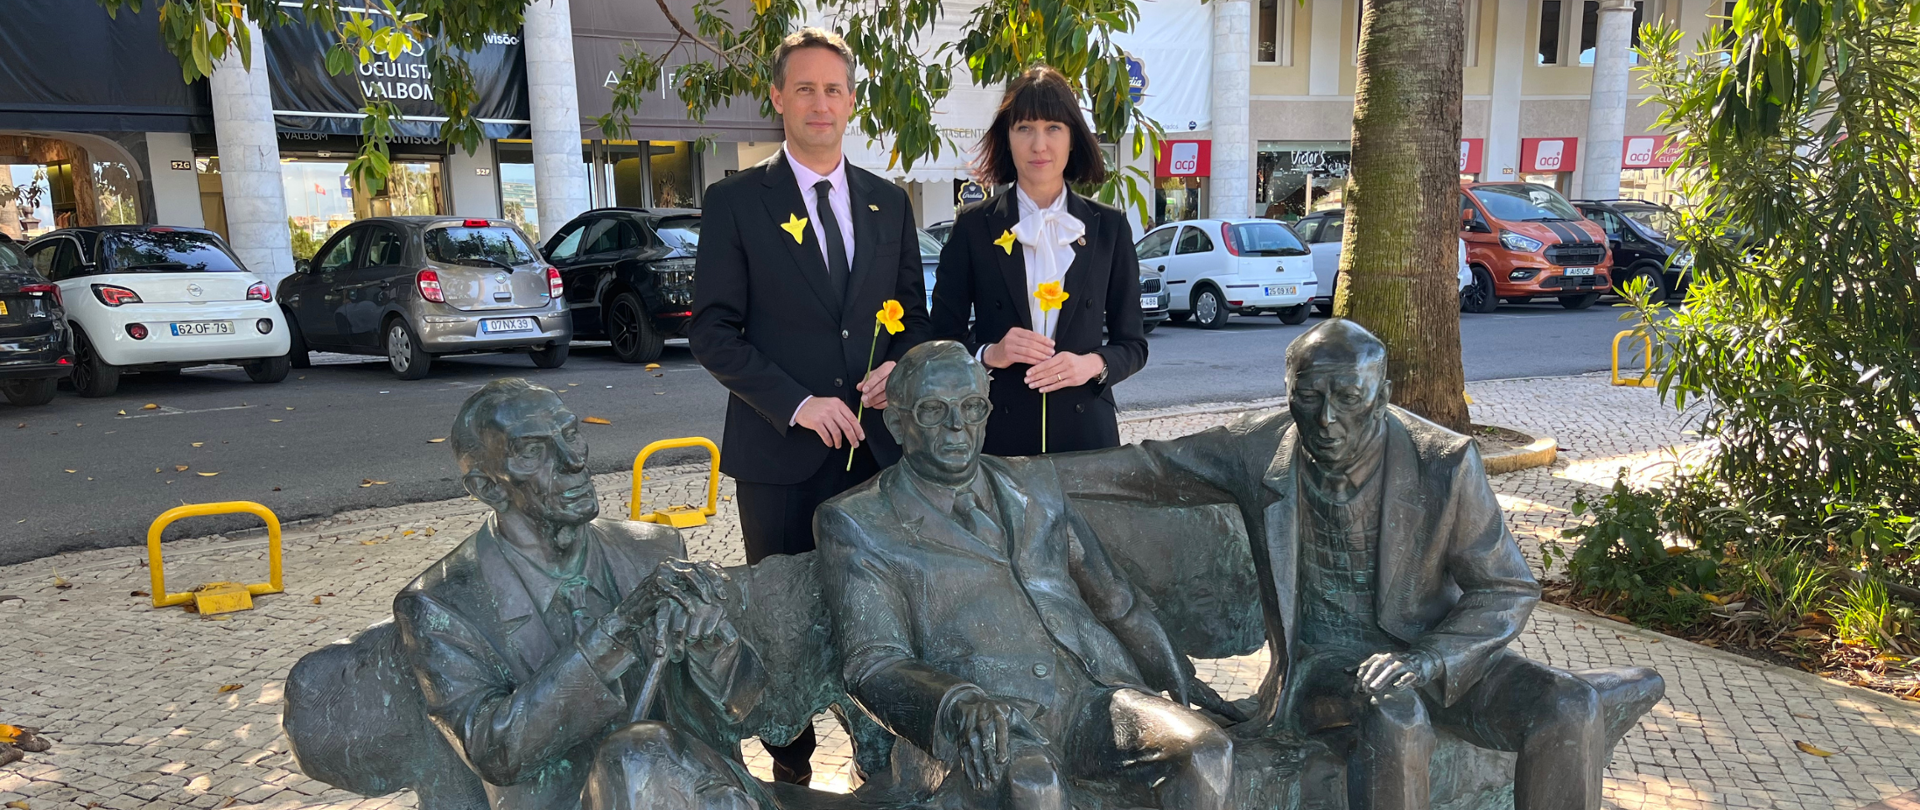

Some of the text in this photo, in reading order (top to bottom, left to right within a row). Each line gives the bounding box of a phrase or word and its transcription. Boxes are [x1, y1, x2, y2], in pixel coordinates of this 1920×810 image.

[284, 132, 328, 141] VALBOM
[1540, 156, 1560, 167] acp
[1630, 153, 1650, 163] acp
[1175, 160, 1195, 172] acp
